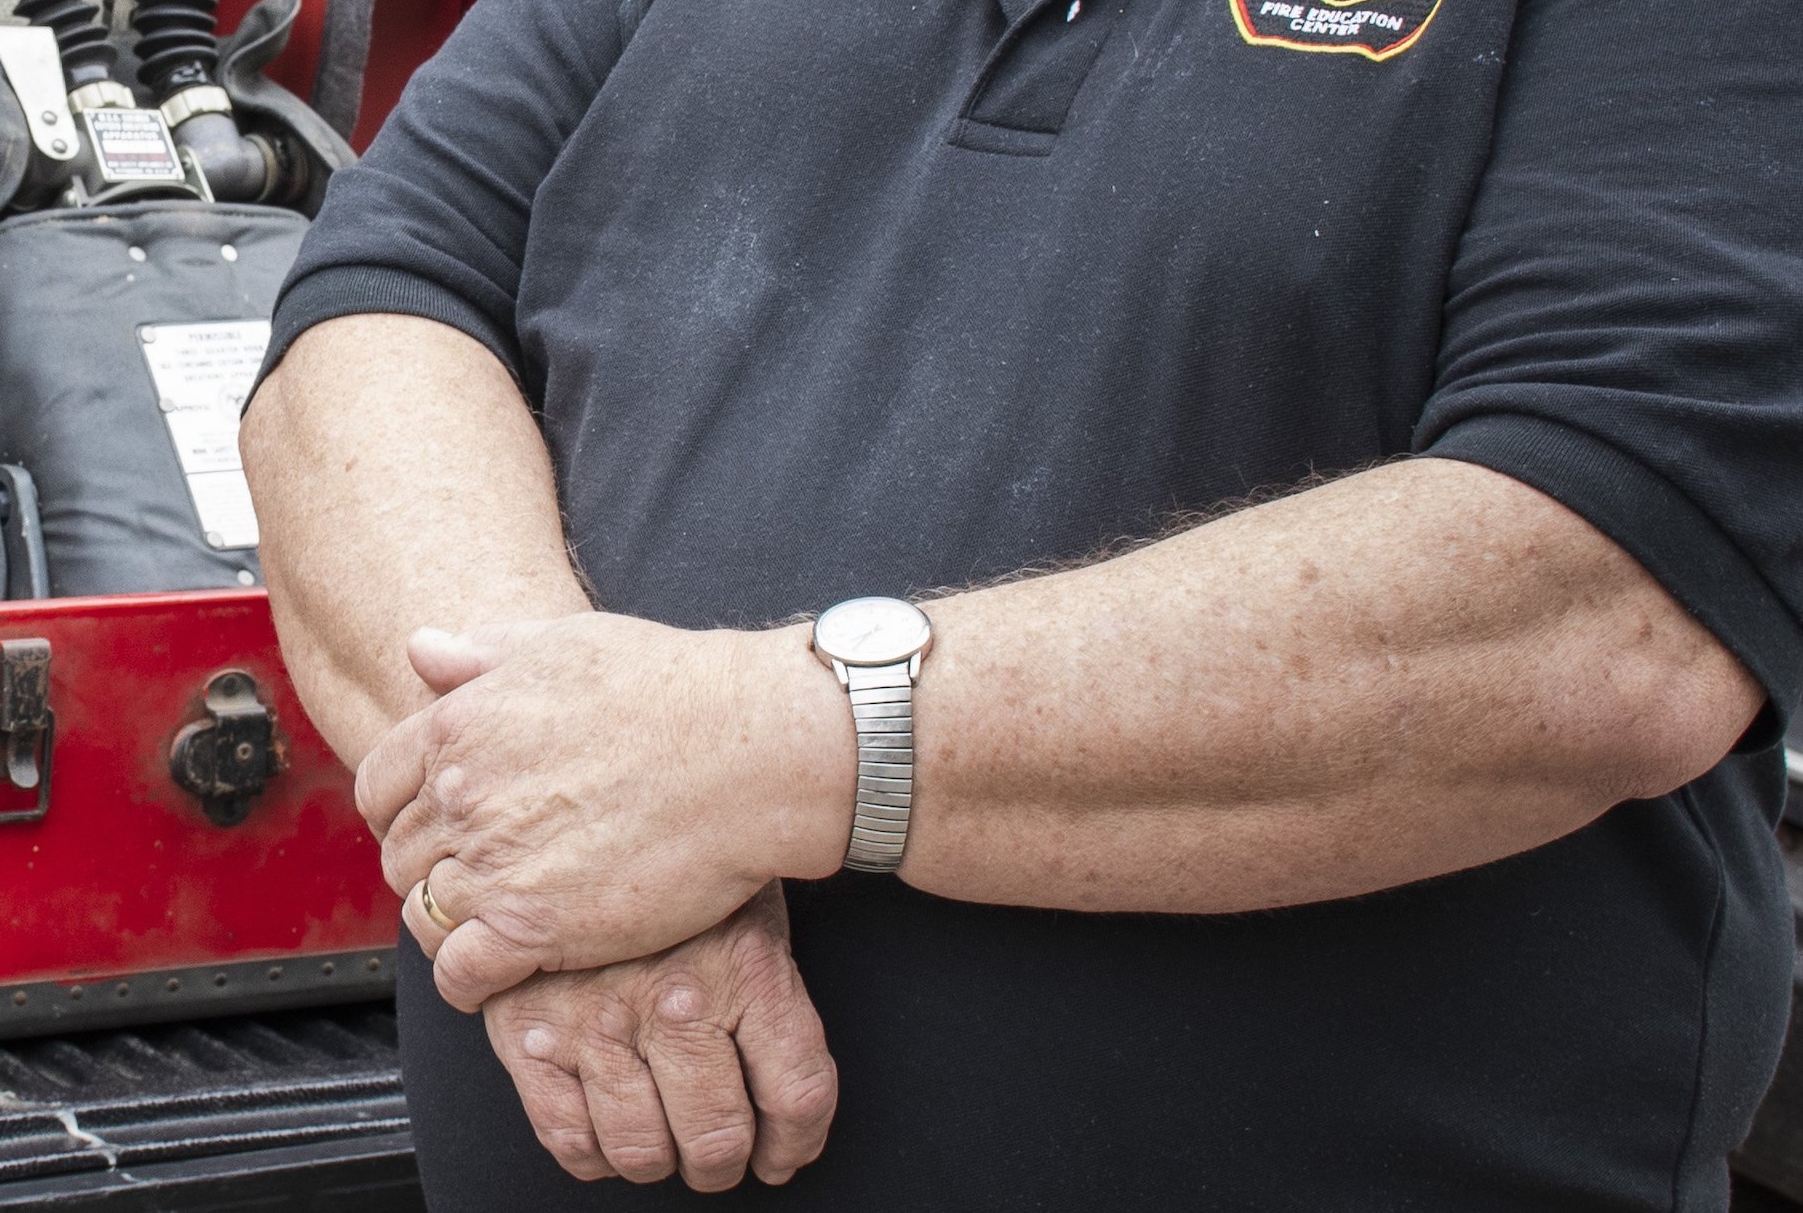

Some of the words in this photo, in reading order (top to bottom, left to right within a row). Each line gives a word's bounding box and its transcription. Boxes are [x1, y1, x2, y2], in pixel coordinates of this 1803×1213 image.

[1260, 1, 1302, 19] FIRE
[1306, 7, 1405, 32] EDUCATION
[1289, 19, 1361, 37] CENTER
